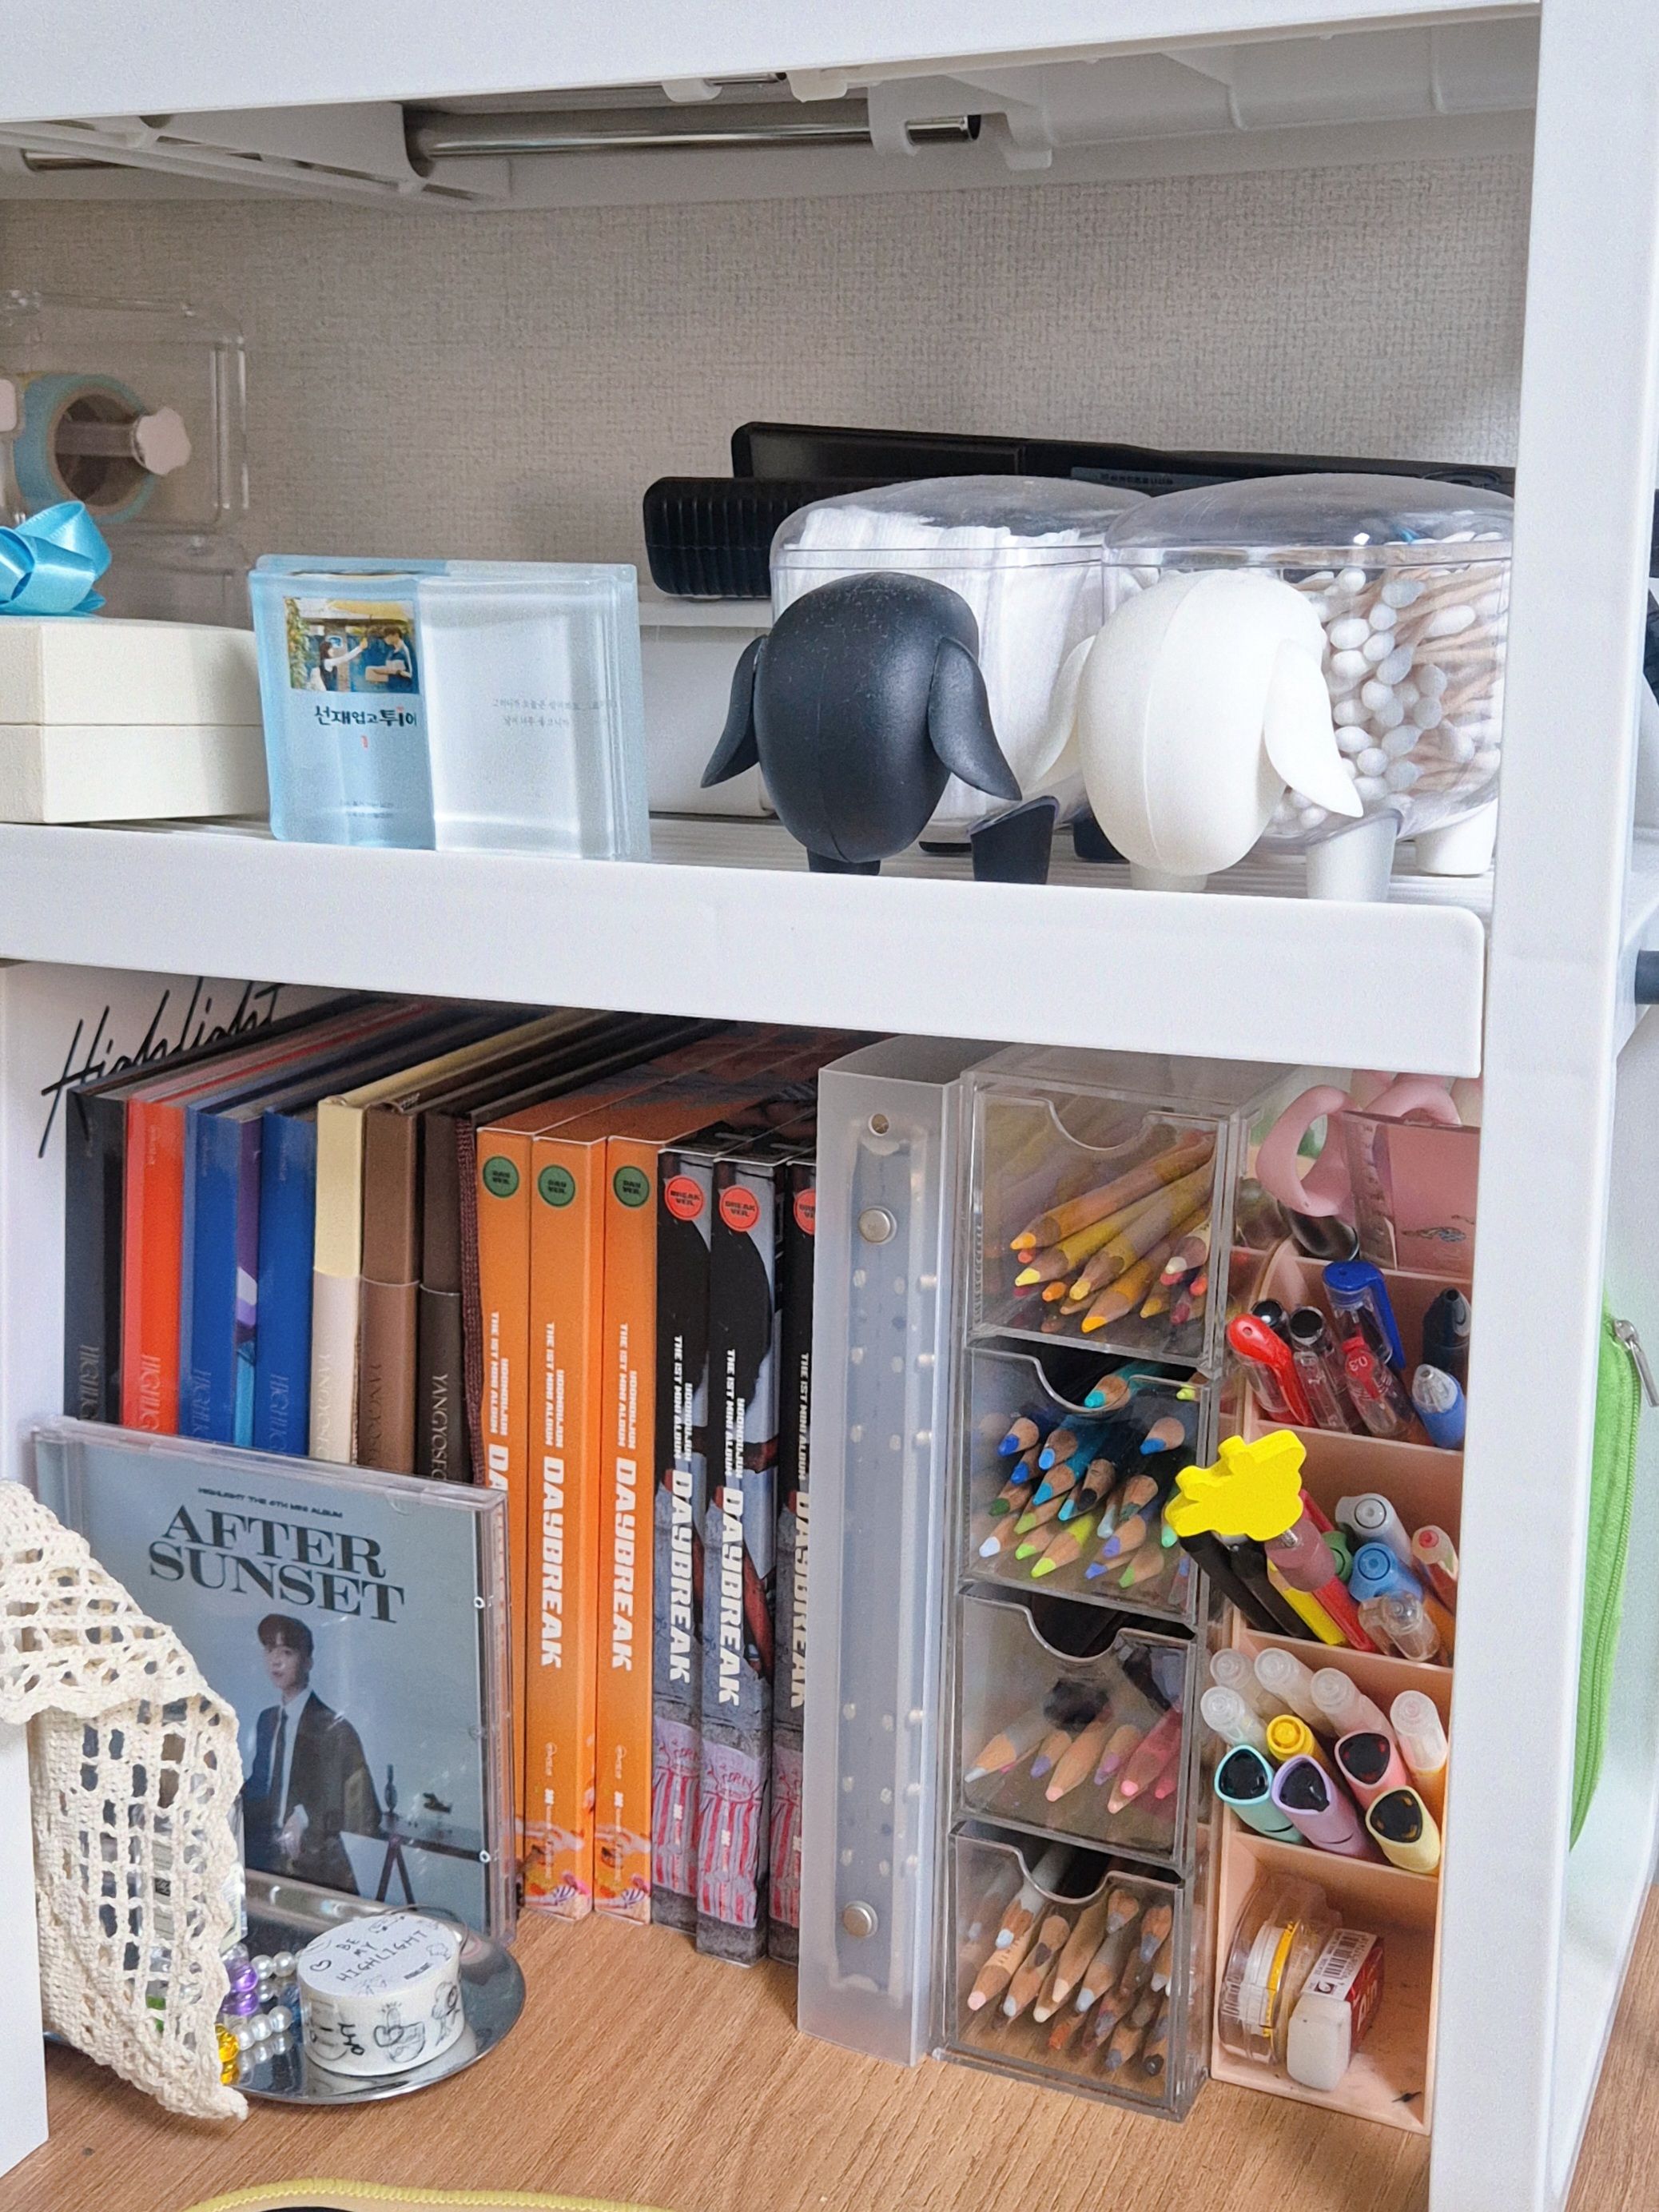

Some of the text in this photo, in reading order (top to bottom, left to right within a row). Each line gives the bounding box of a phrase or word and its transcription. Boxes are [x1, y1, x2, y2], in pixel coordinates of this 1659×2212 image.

[491, 1311, 499, 1335] THE
[546, 1323, 555, 1348] THE
[619, 1323, 628, 1348] THE
[490, 1360, 499, 1389] MINI
[726, 1349, 735, 1375] THE
[800, 1352, 809, 1379] THE
[546, 1372, 555, 1400] MINI
[619, 1373, 627, 1401] MINI
[490, 1390, 499, 1434] ALBUM
[545, 1402, 554, 1446] ALBUM
[618, 1402, 627, 1447] ALBUM
[725, 1399, 734, 1430] MINI
[799, 1404, 808, 1434] MINI
[725, 1430, 734, 1477] ALBUM
[798, 1435, 807, 1481] ALBUM
[161, 1504, 387, 1579] AFTER
[541, 1456, 564, 1669] DAYBREAK
[149, 1540, 405, 1624] SUNSET
[612, 1458, 637, 1671] DAYBREAK
[670, 1470, 693, 1684] DAYBREAK
[719, 1487, 744, 1706] DAYBREAK
[336, 1938, 360, 1951] BE
[336, 1930, 428, 1982] HIGHLIGHT
